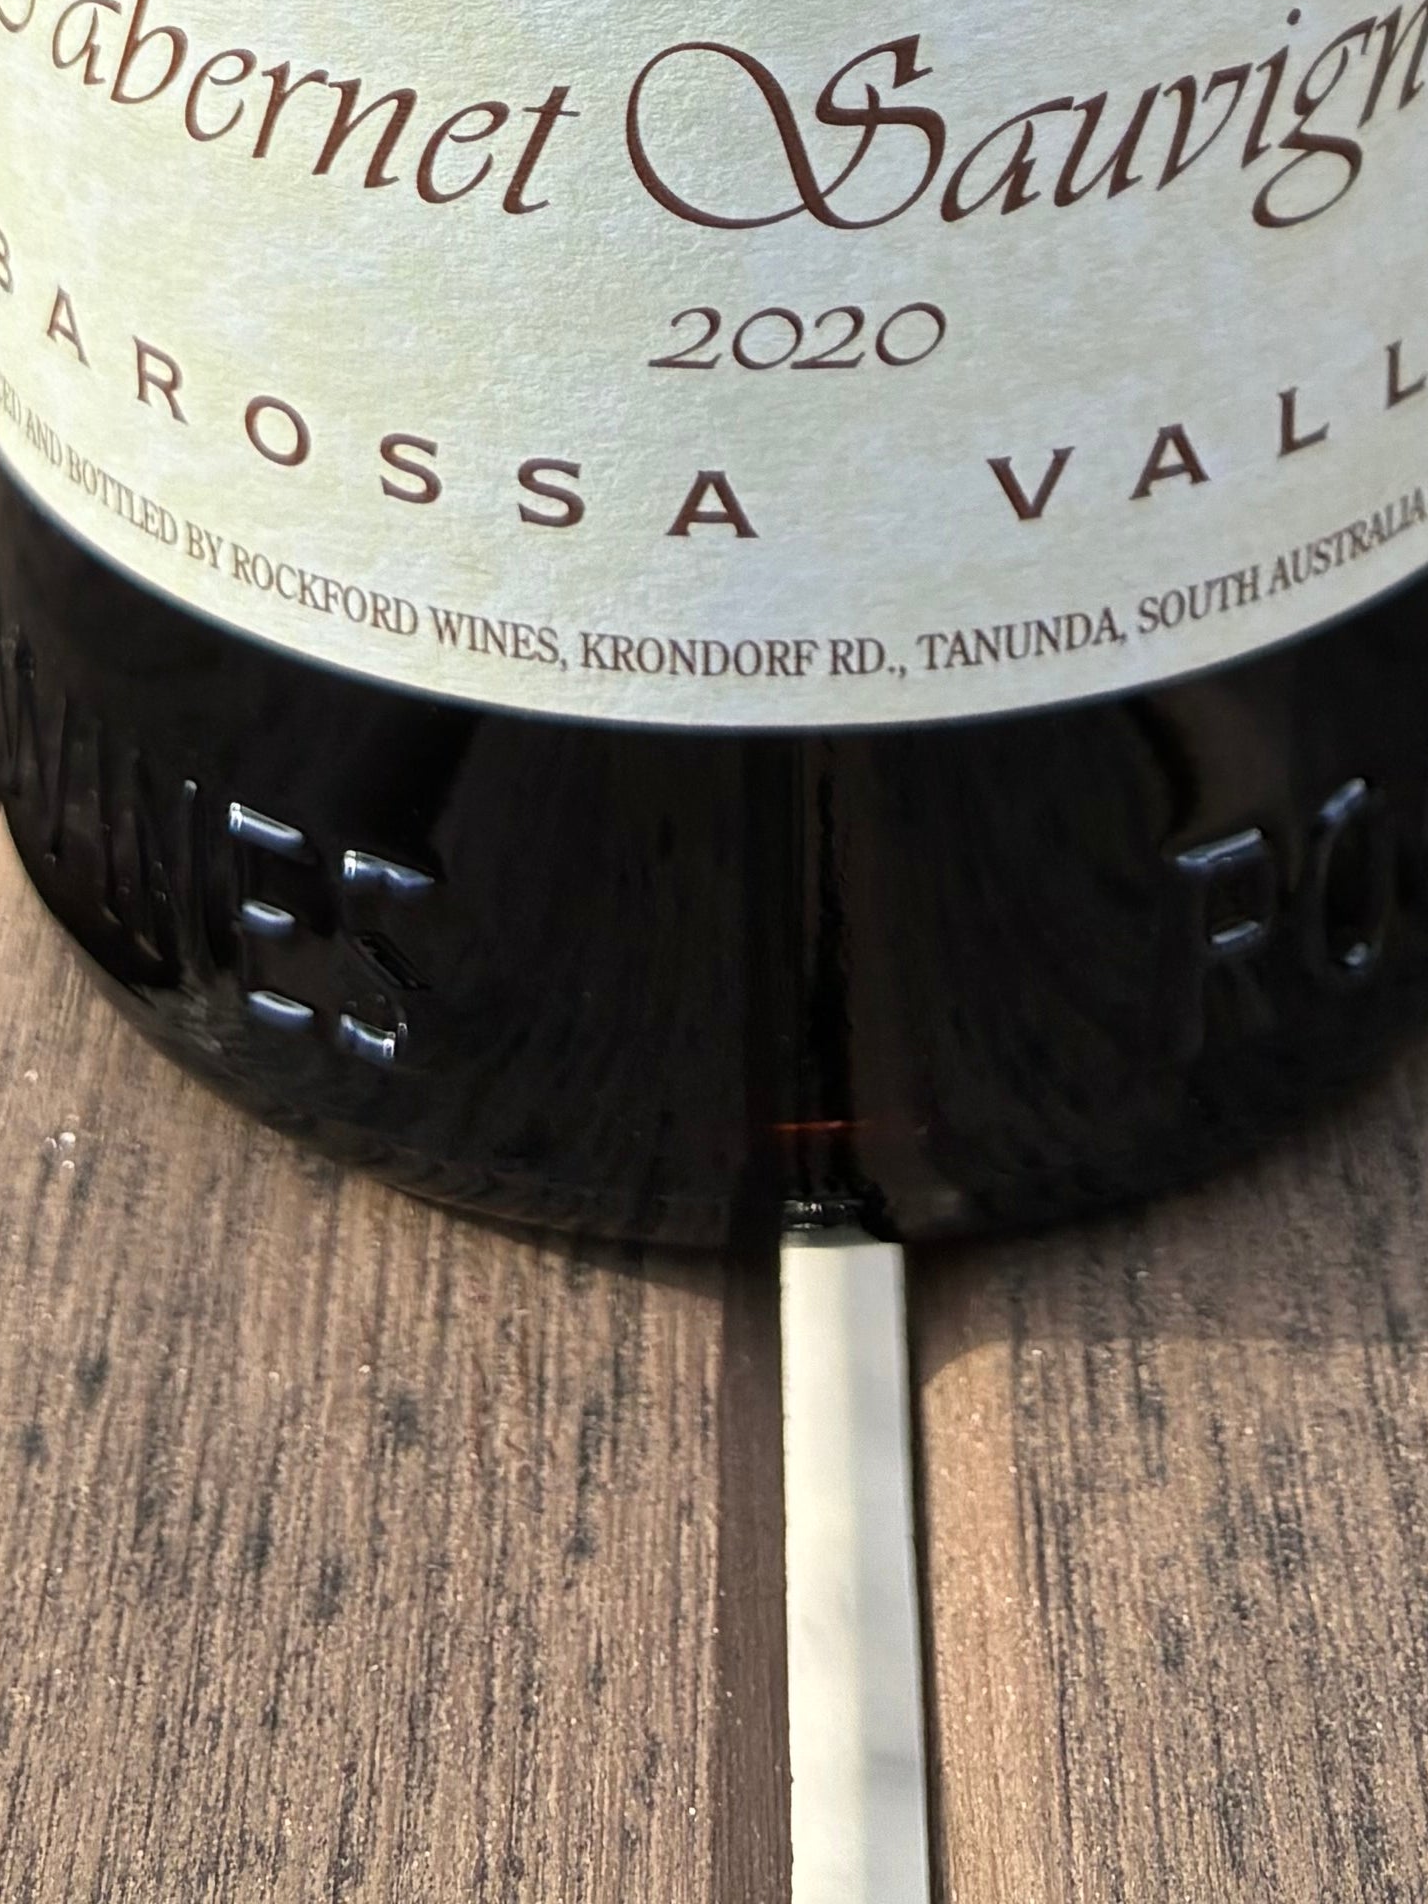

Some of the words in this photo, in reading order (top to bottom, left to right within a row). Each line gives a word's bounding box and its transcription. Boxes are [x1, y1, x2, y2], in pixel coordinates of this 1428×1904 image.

[648, 300, 946, 370] 2020
[26, 408, 62, 467] AND
[66, 444, 178, 545] BOTTLED
[185, 519, 224, 570] BY
[231, 544, 420, 638] ROCKFORD
[428, 604, 568, 672] WINES,
[579, 632, 819, 679] KRONDORF
[828, 628, 907, 679] RD.,
[916, 606, 1125, 671] TANUNDA,
[1136, 562, 1260, 634] SOUTH
[1267, 485, 1428, 596] AUSTRALIA
